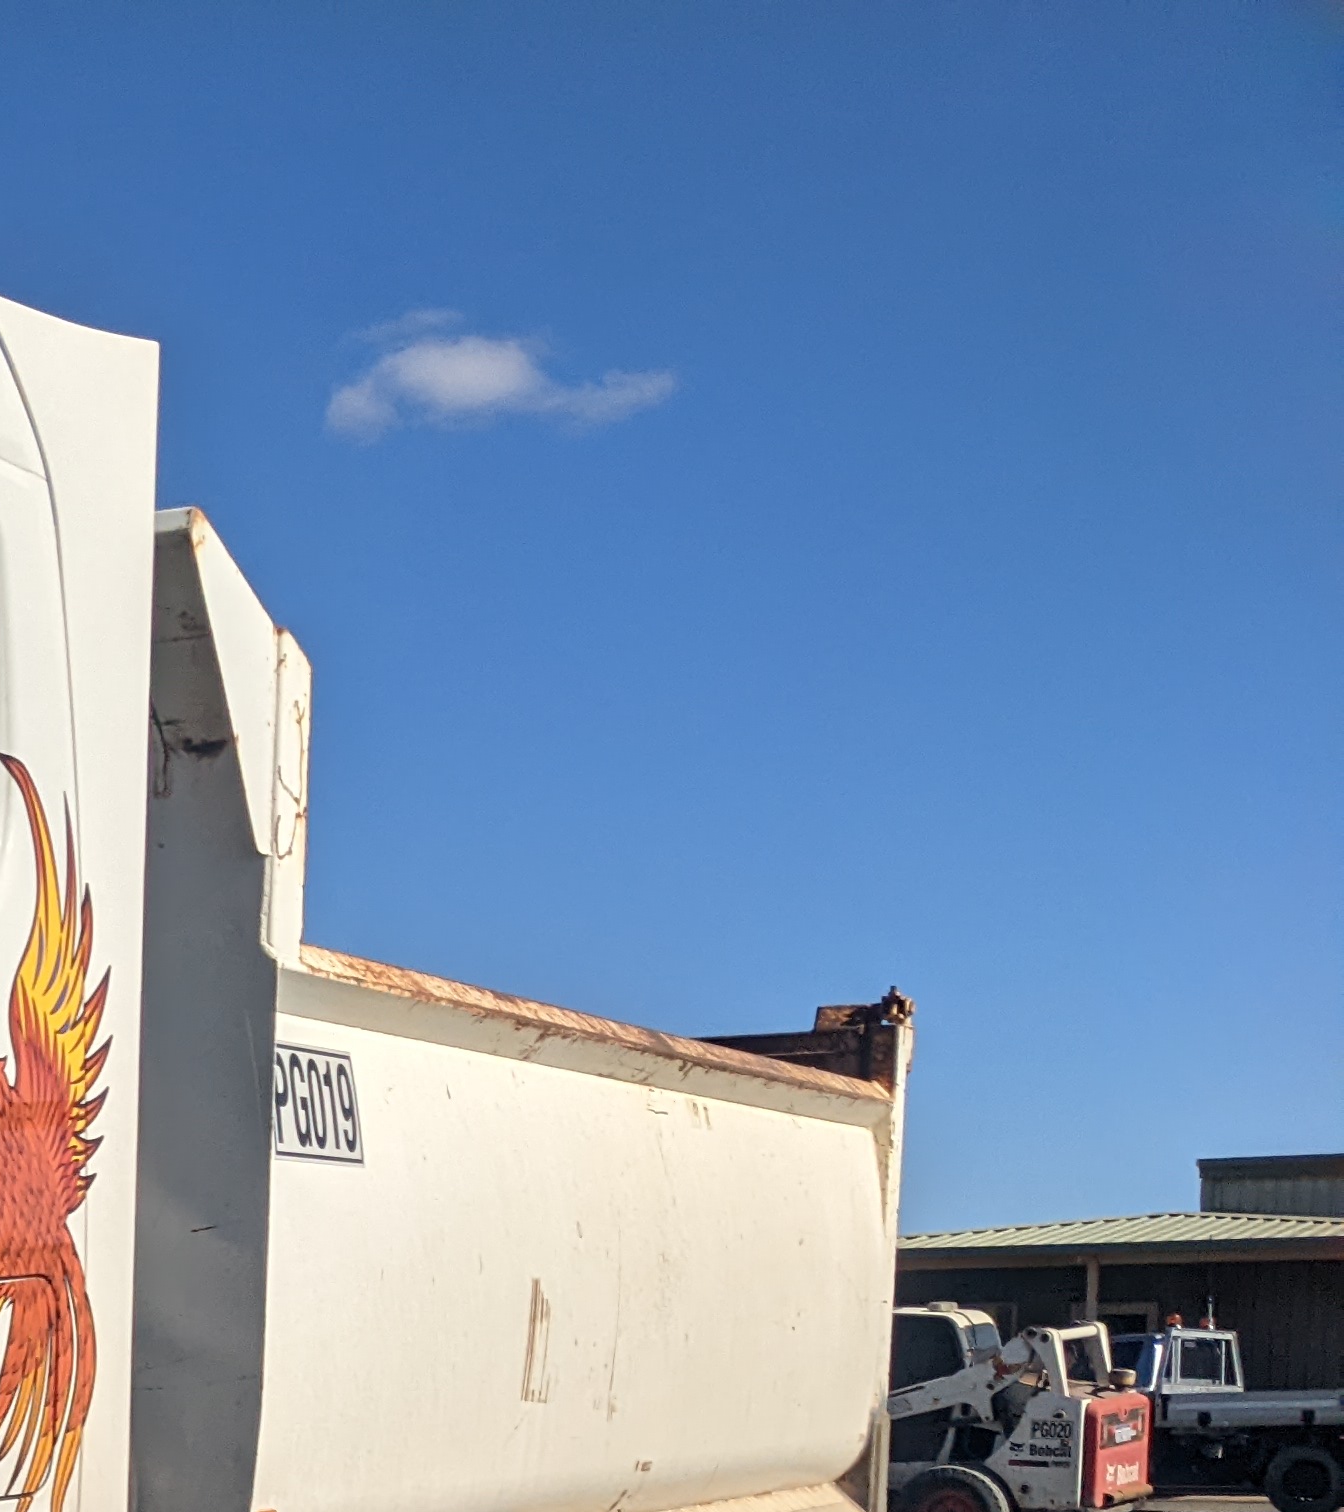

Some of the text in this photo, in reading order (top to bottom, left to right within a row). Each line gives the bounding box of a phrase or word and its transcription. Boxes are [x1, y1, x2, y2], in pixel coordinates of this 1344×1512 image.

[274, 1052, 357, 1152] PG019
[1031, 1421, 1072, 1438] PG020
[1029, 1443, 1072, 1458] Bobcat
